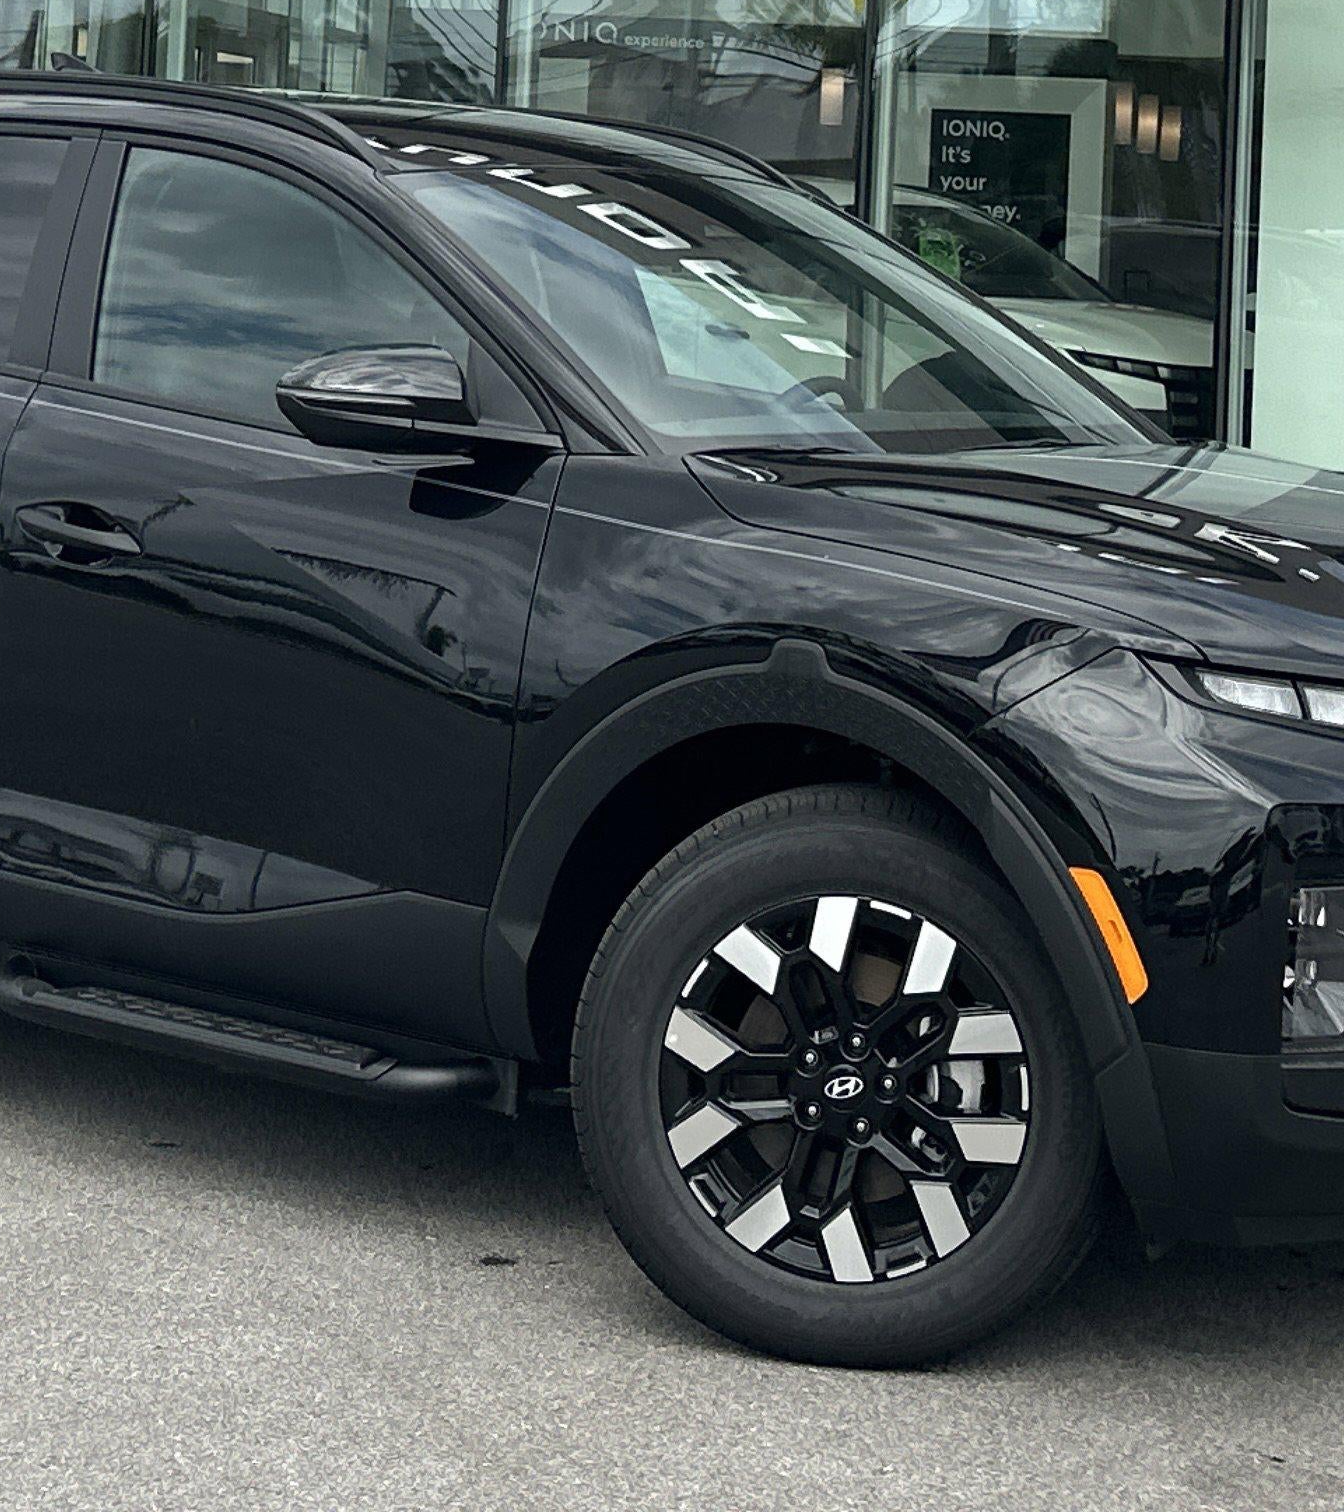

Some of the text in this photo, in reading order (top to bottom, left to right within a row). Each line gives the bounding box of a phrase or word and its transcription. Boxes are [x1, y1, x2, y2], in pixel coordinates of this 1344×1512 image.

[623, 34, 705, 49] experience
[942, 118, 1011, 141] IONIQ.
[939, 174, 988, 191] your
